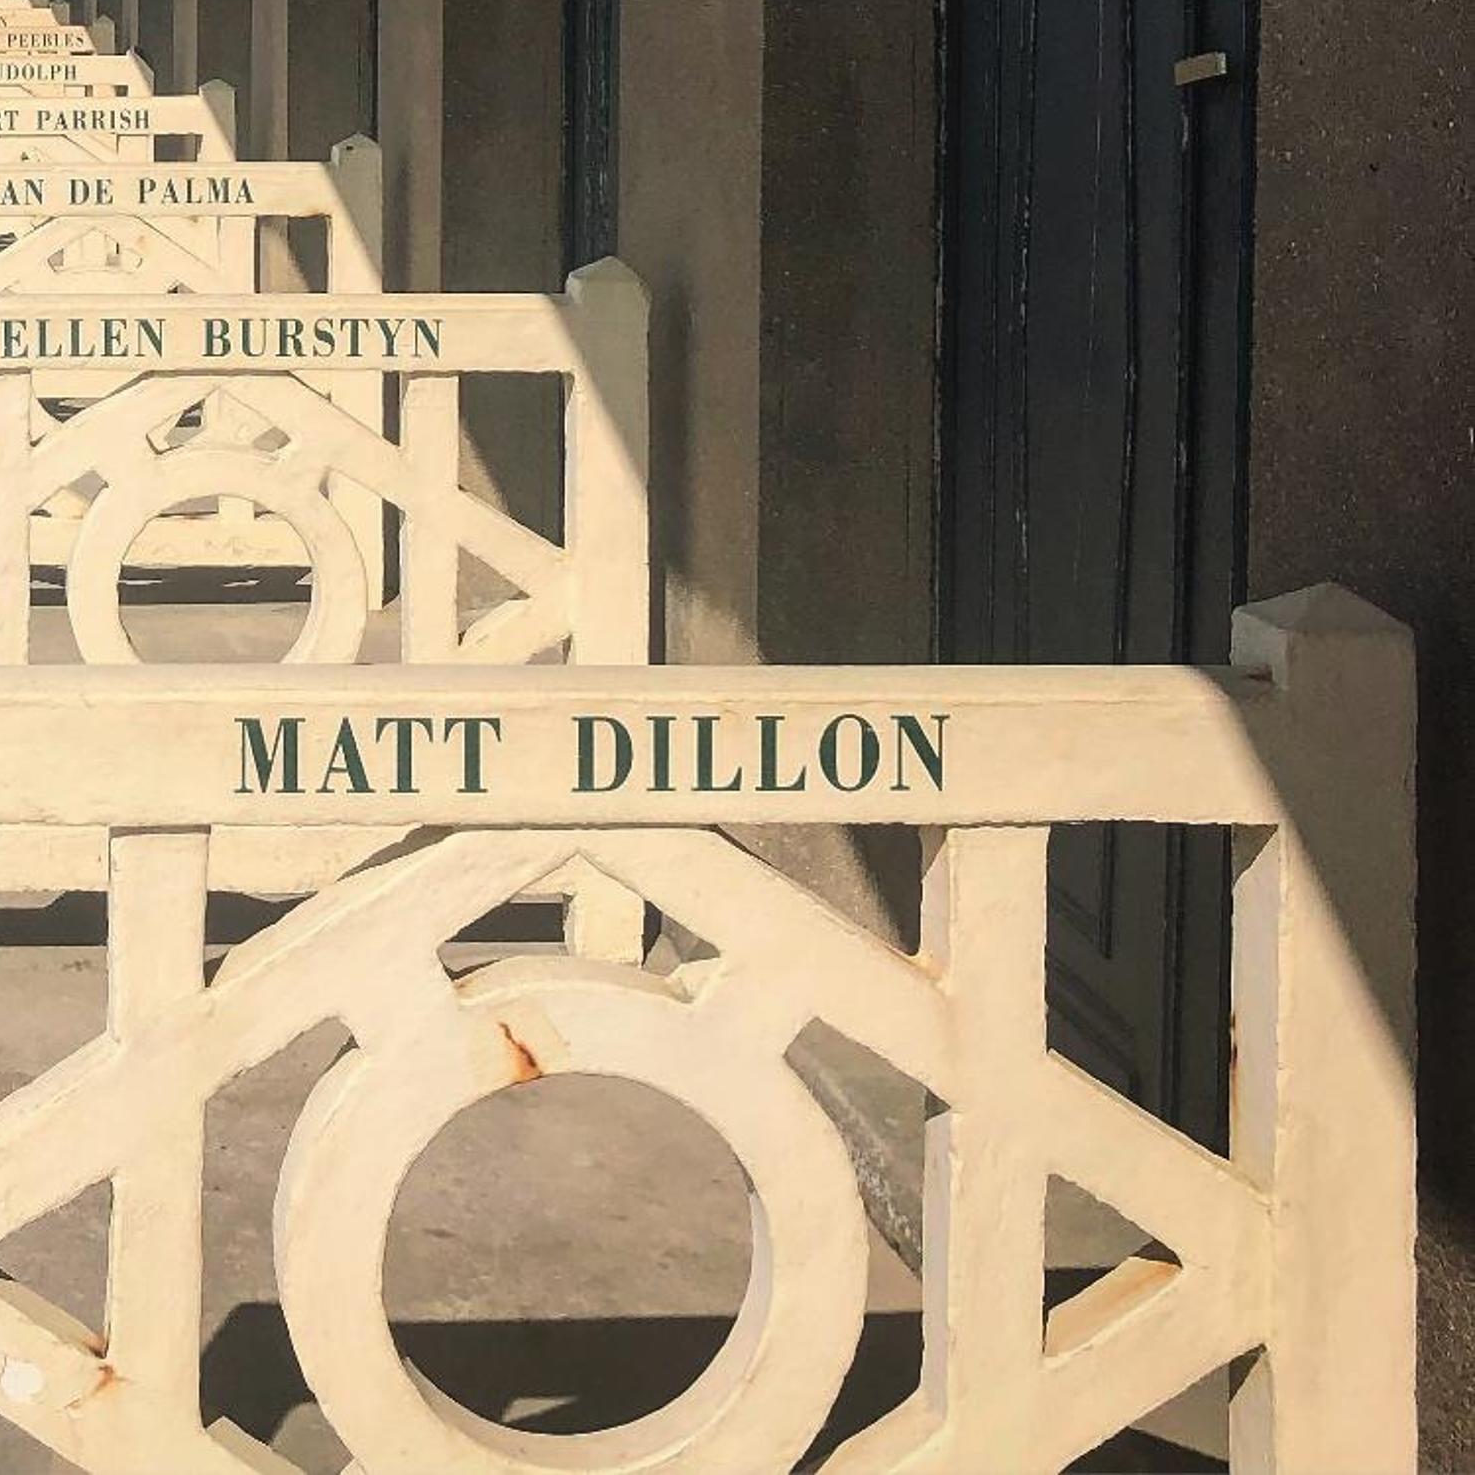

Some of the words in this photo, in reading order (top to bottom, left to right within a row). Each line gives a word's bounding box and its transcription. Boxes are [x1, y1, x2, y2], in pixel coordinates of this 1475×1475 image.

[7, 32, 86, 48] PEEBLES
[36, 109, 151, 130] PARRISH
[69, 178, 114, 206] DE
[138, 177, 255, 205] PALMA
[0, 318, 166, 359] ELLEN
[201, 317, 443, 359] BURSTYN
[233, 717, 502, 794] MATT
[571, 710, 951, 793] DILLON
